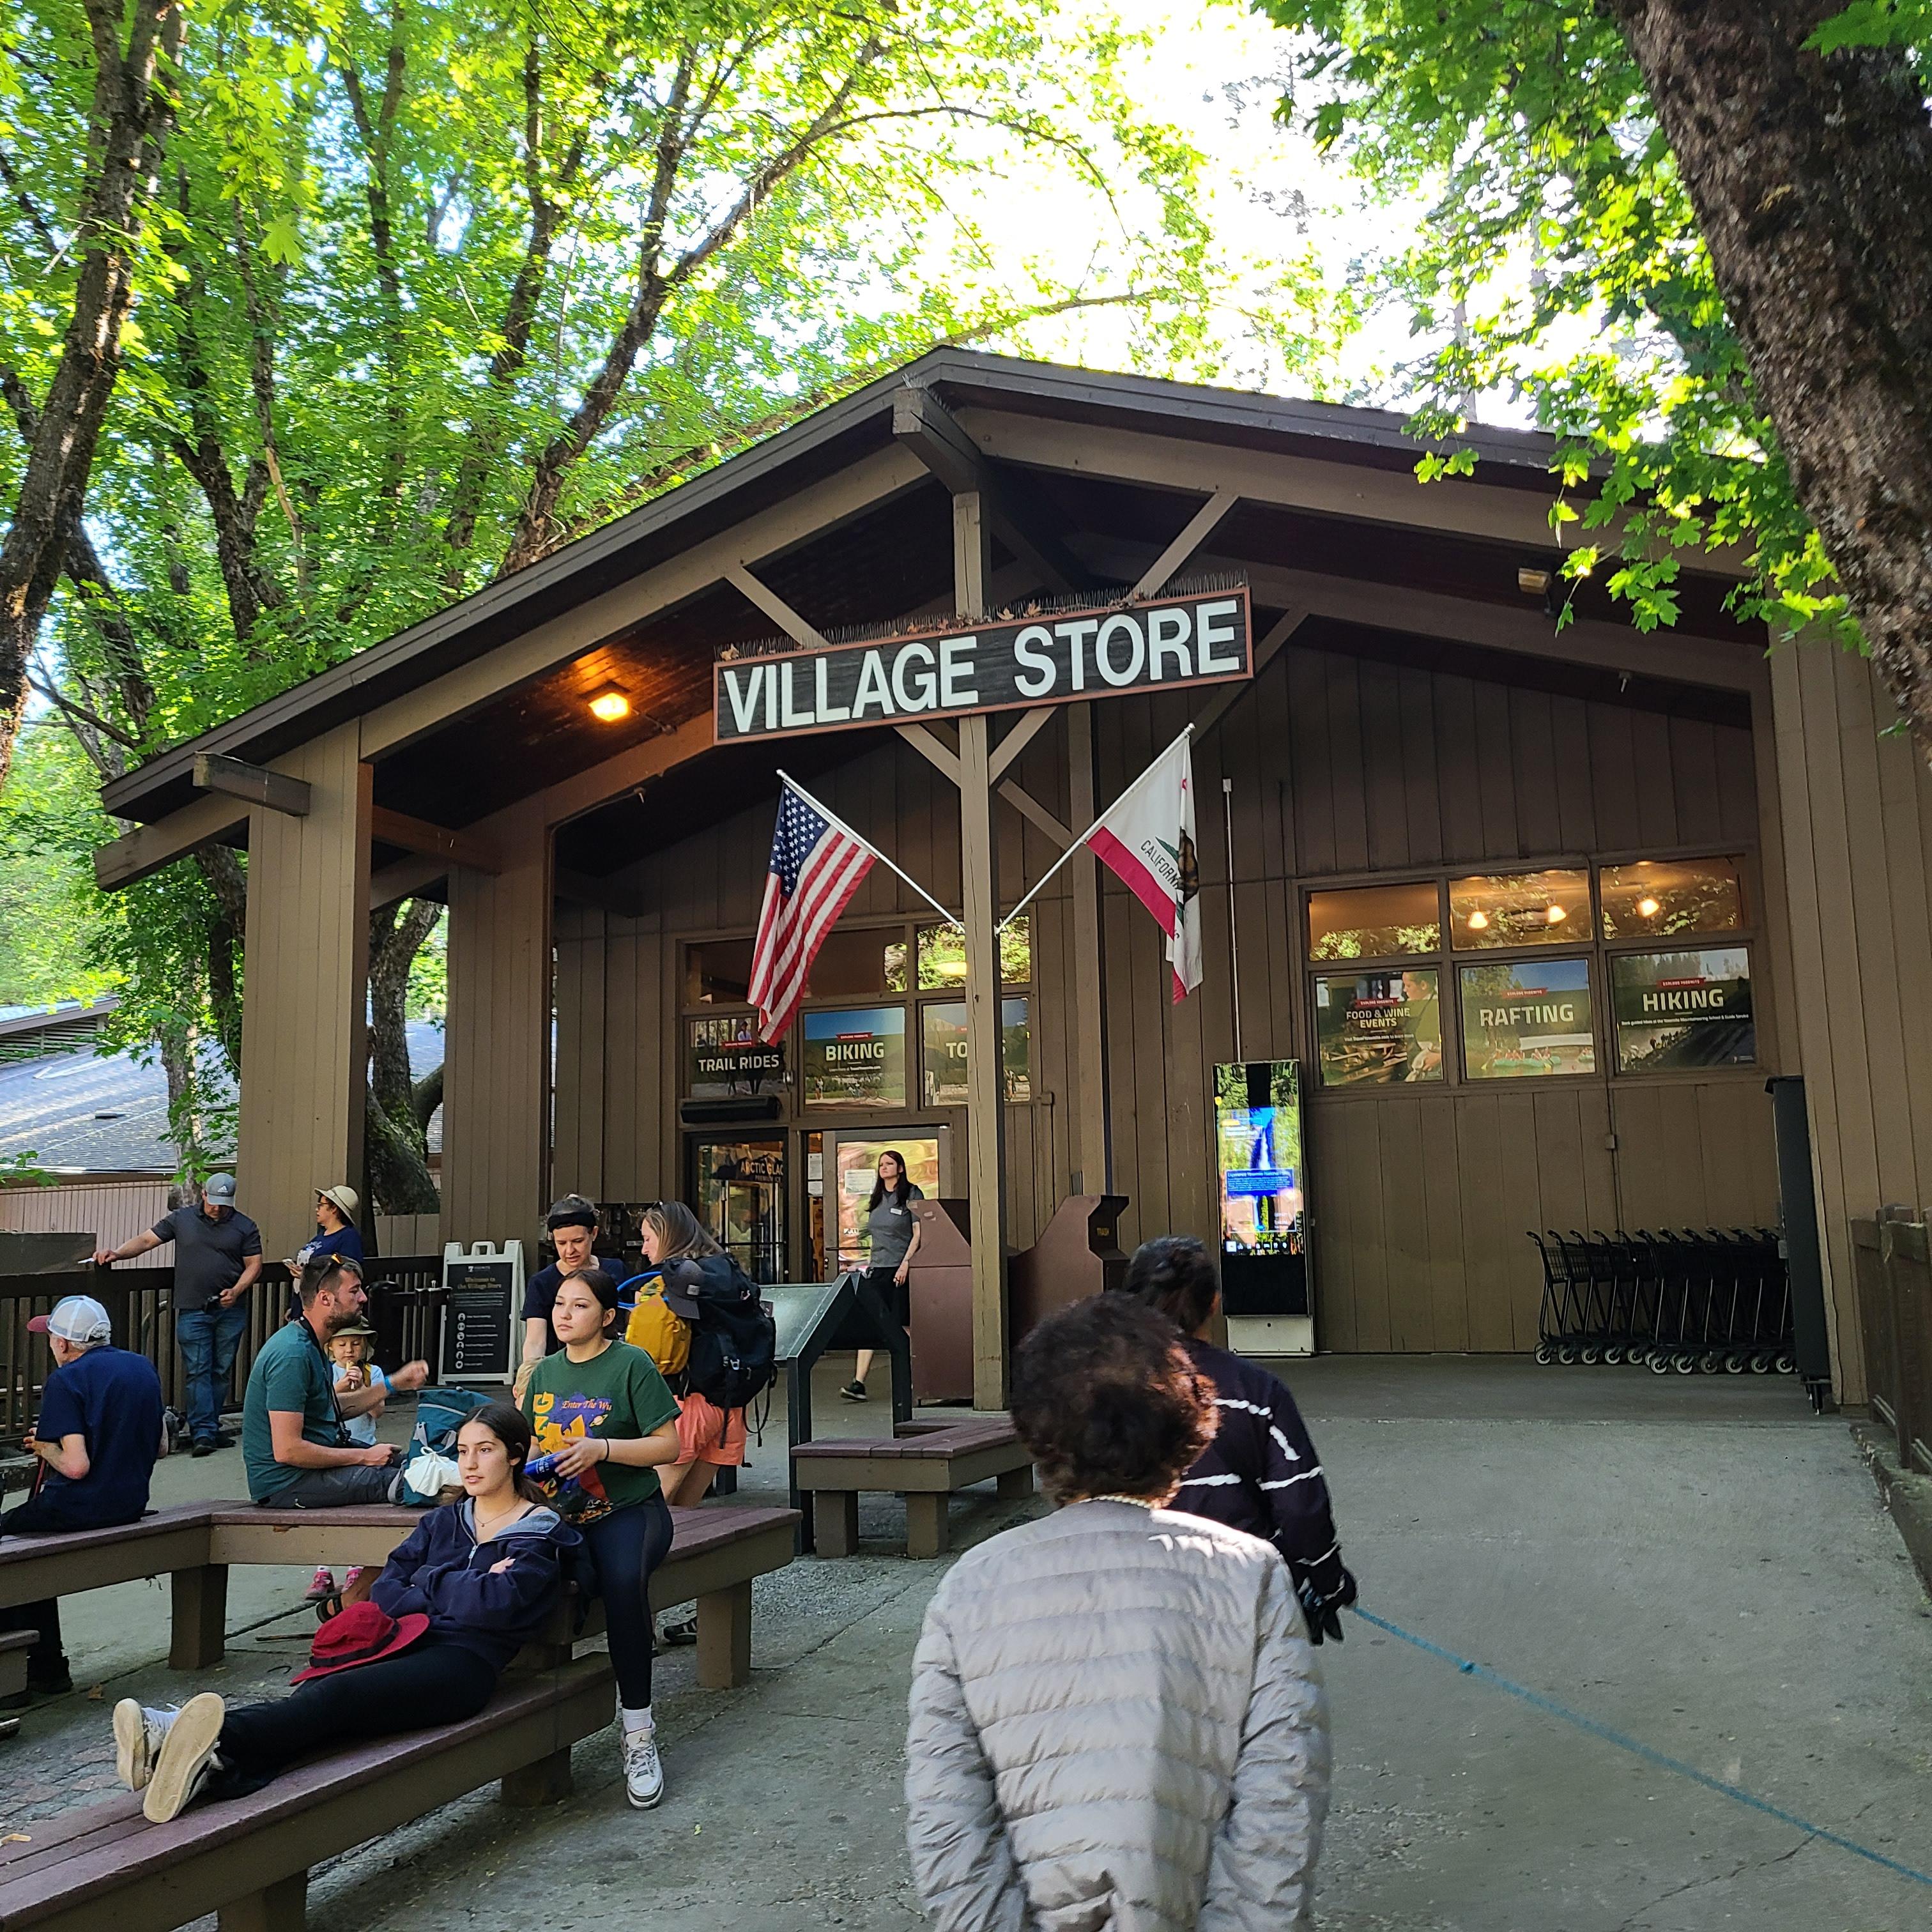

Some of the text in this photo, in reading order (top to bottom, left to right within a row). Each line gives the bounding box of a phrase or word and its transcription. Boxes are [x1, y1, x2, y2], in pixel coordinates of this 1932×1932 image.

[723, 599, 1240, 733] VILLAGE STORE
[1140, 839, 1178, 889] CALIFORN
[1643, 988, 1724, 1012] HIKING
[1346, 1008, 1411, 1020] FOOD & WINE
[1360, 1018, 1397, 1028] EVENTS
[1480, 1004, 1574, 1027] RAFTING
[825, 1042, 884, 1061] BIKING
[698, 1054, 779, 1072] TRAIL RIDES
[741, 1162, 783, 1176] ARCTIC GLAC
[562, 1398, 612, 1411] Enter The Wu
